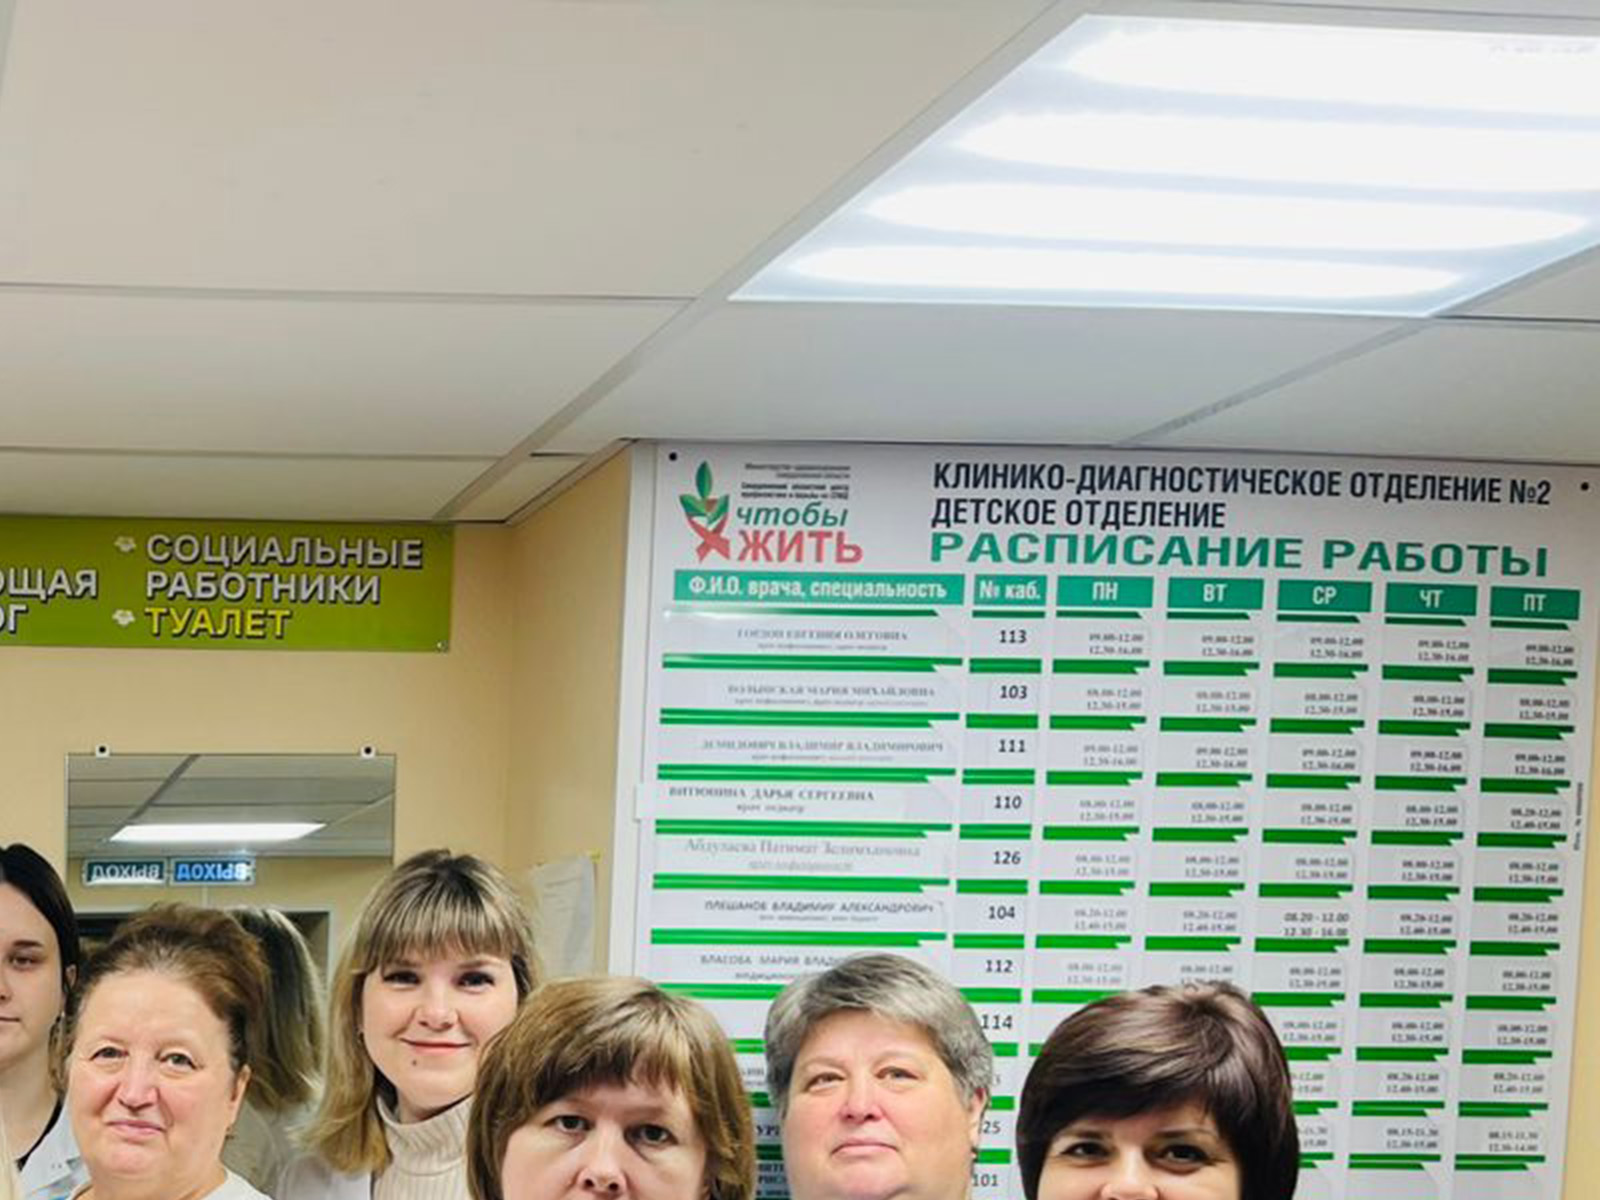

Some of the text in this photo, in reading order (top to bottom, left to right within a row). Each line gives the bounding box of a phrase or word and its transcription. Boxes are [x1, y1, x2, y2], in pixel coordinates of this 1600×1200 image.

[933, 463, 1551, 506] КЛИНИКО-ДИАГНОСТИЧЕСКОЕ ОТДЕЛЕНИЕ №2
[736, 502, 848, 527] чтобы
[931, 498, 1227, 530] ДЕТСКОЕ ОТДЕЛЕНИЕ
[146, 535, 423, 571] СОЦИАЛЬНЫЕ
[738, 530, 863, 563] ЖИТЬ
[931, 533, 1548, 577] РАСПИСАНИЕ РАБОТЫ
[146, 571, 381, 603] РАБОТНИКИ
[689, 575, 743, 595] Ф.И.О.
[811, 580, 947, 601] специальность
[1004, 579, 1040, 599] каб.
[1093, 582, 1118, 600] ПН
[1203, 584, 1227, 602] ВТ
[1313, 586, 1337, 605] СР
[1420, 590, 1443, 607] ЧТ
[1523, 594, 1546, 611] ПТ
[146, 606, 291, 638] ТУАЛЕТ
[999, 629, 1028, 643] 113
[1000, 686, 1028, 699] 103
[999, 739, 1025, 752] 111
[995, 796, 1022, 809] 110
[994, 851, 1020, 864] 126
[988, 906, 1015, 919] 104
[986, 960, 1013, 972] 112
[982, 1015, 1013, 1029] 114
[983, 1122, 1000, 1133] 25
[973, 1175, 999, 1186] 101
